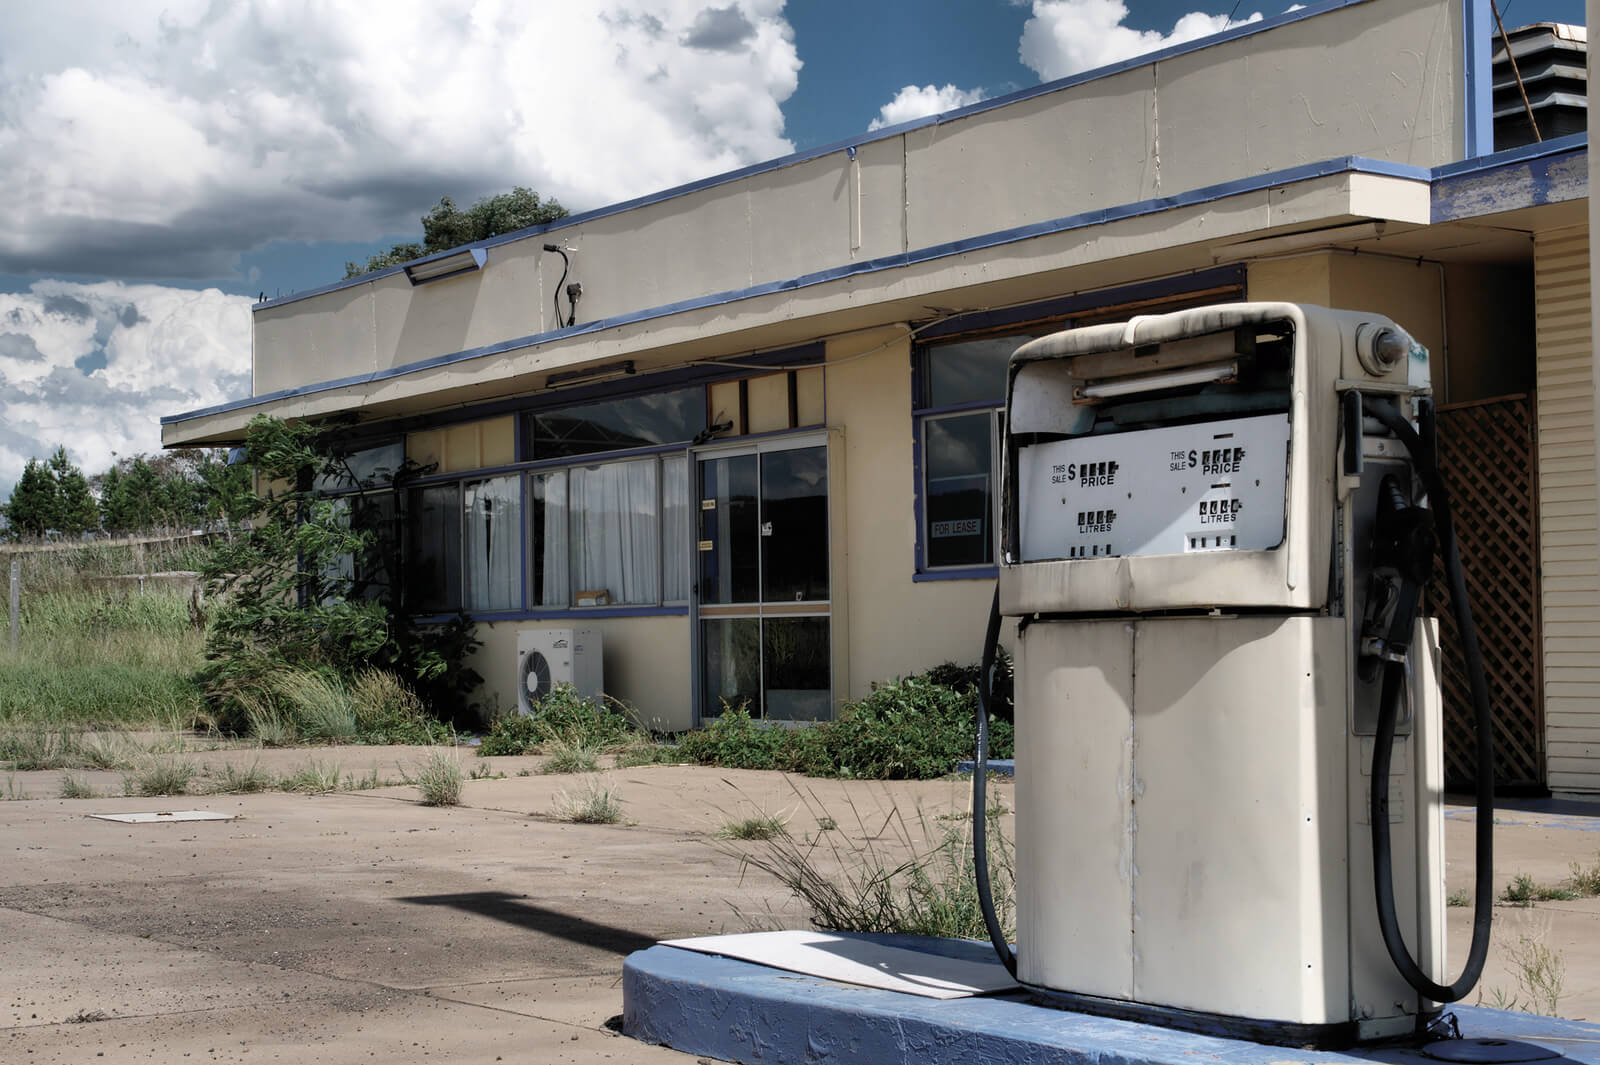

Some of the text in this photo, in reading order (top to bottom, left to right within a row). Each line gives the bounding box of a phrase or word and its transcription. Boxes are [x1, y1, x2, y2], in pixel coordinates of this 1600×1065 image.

[1170, 451, 1185, 460] THIS
[1052, 464, 1066, 474] THIS
[1169, 461, 1186, 472] SALE
[1202, 462, 1240, 475] PRICE
[1051, 474, 1067, 484] SALE
[1081, 475, 1114, 488] PRICE
[1200, 513, 1237, 524] LITRES
[935, 520, 977, 535] FOR LEASE
[1079, 523, 1112, 534] LITRES
